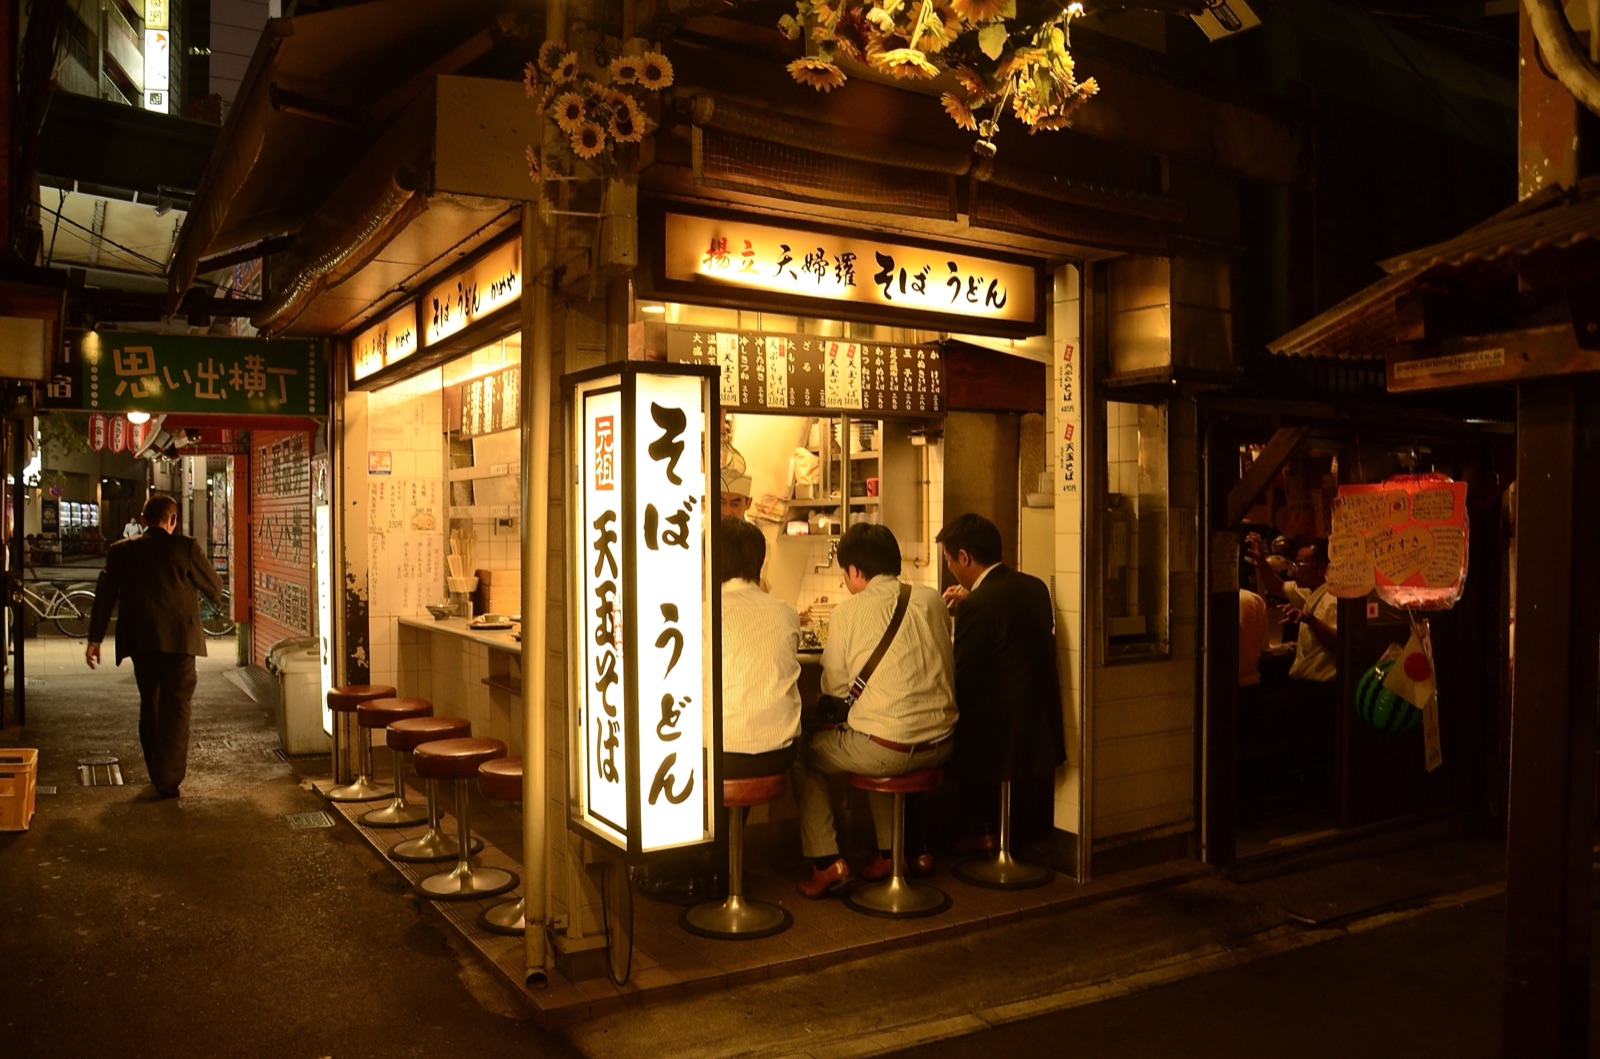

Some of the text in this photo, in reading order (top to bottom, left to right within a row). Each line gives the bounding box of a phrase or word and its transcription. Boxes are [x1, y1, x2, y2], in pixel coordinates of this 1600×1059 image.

[702, 236, 1008, 310] 揚立 天婦羅 そば うどん
[433, 294, 451, 336] そば
[457, 281, 481, 318] うどん
[47, 340, 73, 398] 宿
[112, 345, 298, 404] 思い出横丁
[739, 336, 750, 380] 冷しきつね
[754, 336, 765, 381] 冷したぬき
[787, 339, 797, 374] 大もり
[802, 340, 812, 373] ざる
[862, 345, 870, 375] きつね
[875, 346, 884, 376] わかめ
[903, 348, 912, 378] 玉子
[917, 349, 926, 379] たぬき
[930, 350, 940, 380] かけ
[595, 419, 614, 487] 元祖
[1064, 442, 1075, 481] 天玉そば
[643, 401, 697, 550] そば
[648, 602, 695, 806] うどん
